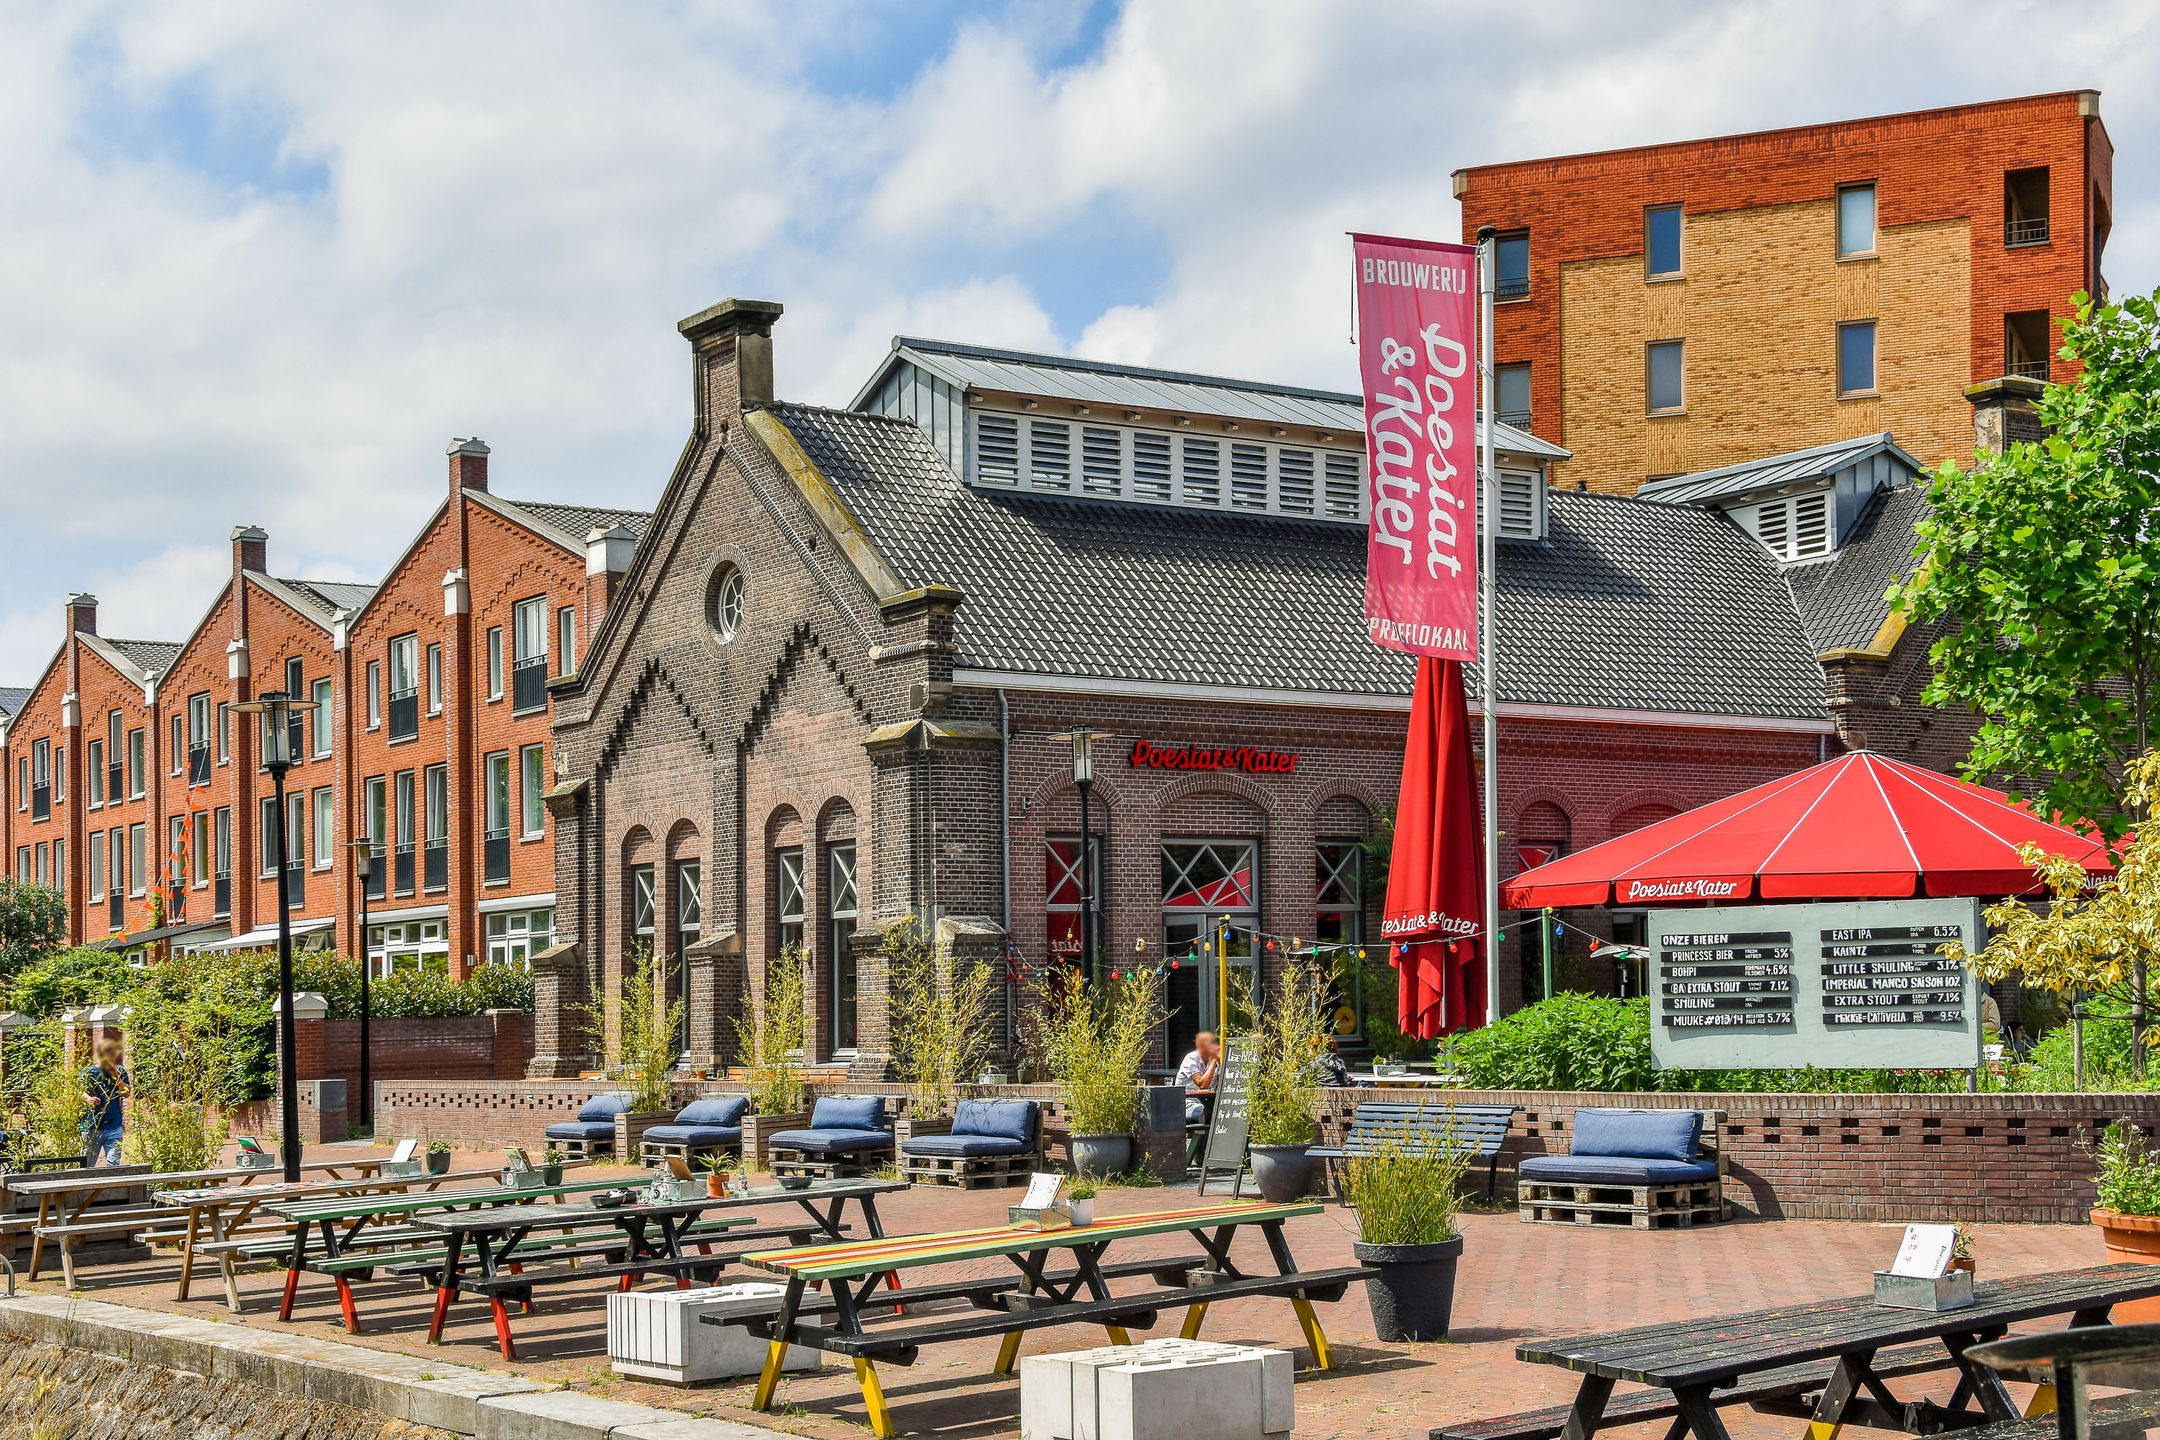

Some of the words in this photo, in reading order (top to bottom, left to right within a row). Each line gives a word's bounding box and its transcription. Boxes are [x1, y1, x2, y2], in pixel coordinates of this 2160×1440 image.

[1362, 258, 1466, 295] BROUWERIJ
[1418, 322, 1467, 580] Poesiat
[1662, 935, 1690, 946] ONZE
[1693, 934, 1729, 945] BIEREN
[1832, 929, 1855, 940] EAST
[1858, 928, 1873, 939] IPA
[1933, 926, 1958, 937] 6.5%
[1672, 950, 1713, 962] PRINCESSE
[1716, 948, 1734, 960] BIER
[1774, 947, 1789, 959] 5%
[1672, 966, 1697, 977] BOHPI
[1765, 964, 1788, 975] 4.6%
[1833, 963, 1866, 975] LITTLE
[1936, 960, 1959, 971] 3.1%
[1687, 982, 1713, 993] EXTRA
[1714, 980, 1741, 992] STOUT
[1769, 980, 1790, 991] 7.1%
[1945, 975, 1961, 987] 10%
[1834, 995, 1864, 1006] EXTRA
[1867, 994, 1900, 1006] STOUT
[1937, 992, 1960, 1003] 7.1%
[1767, 1012, 1791, 1023] 5.7%
